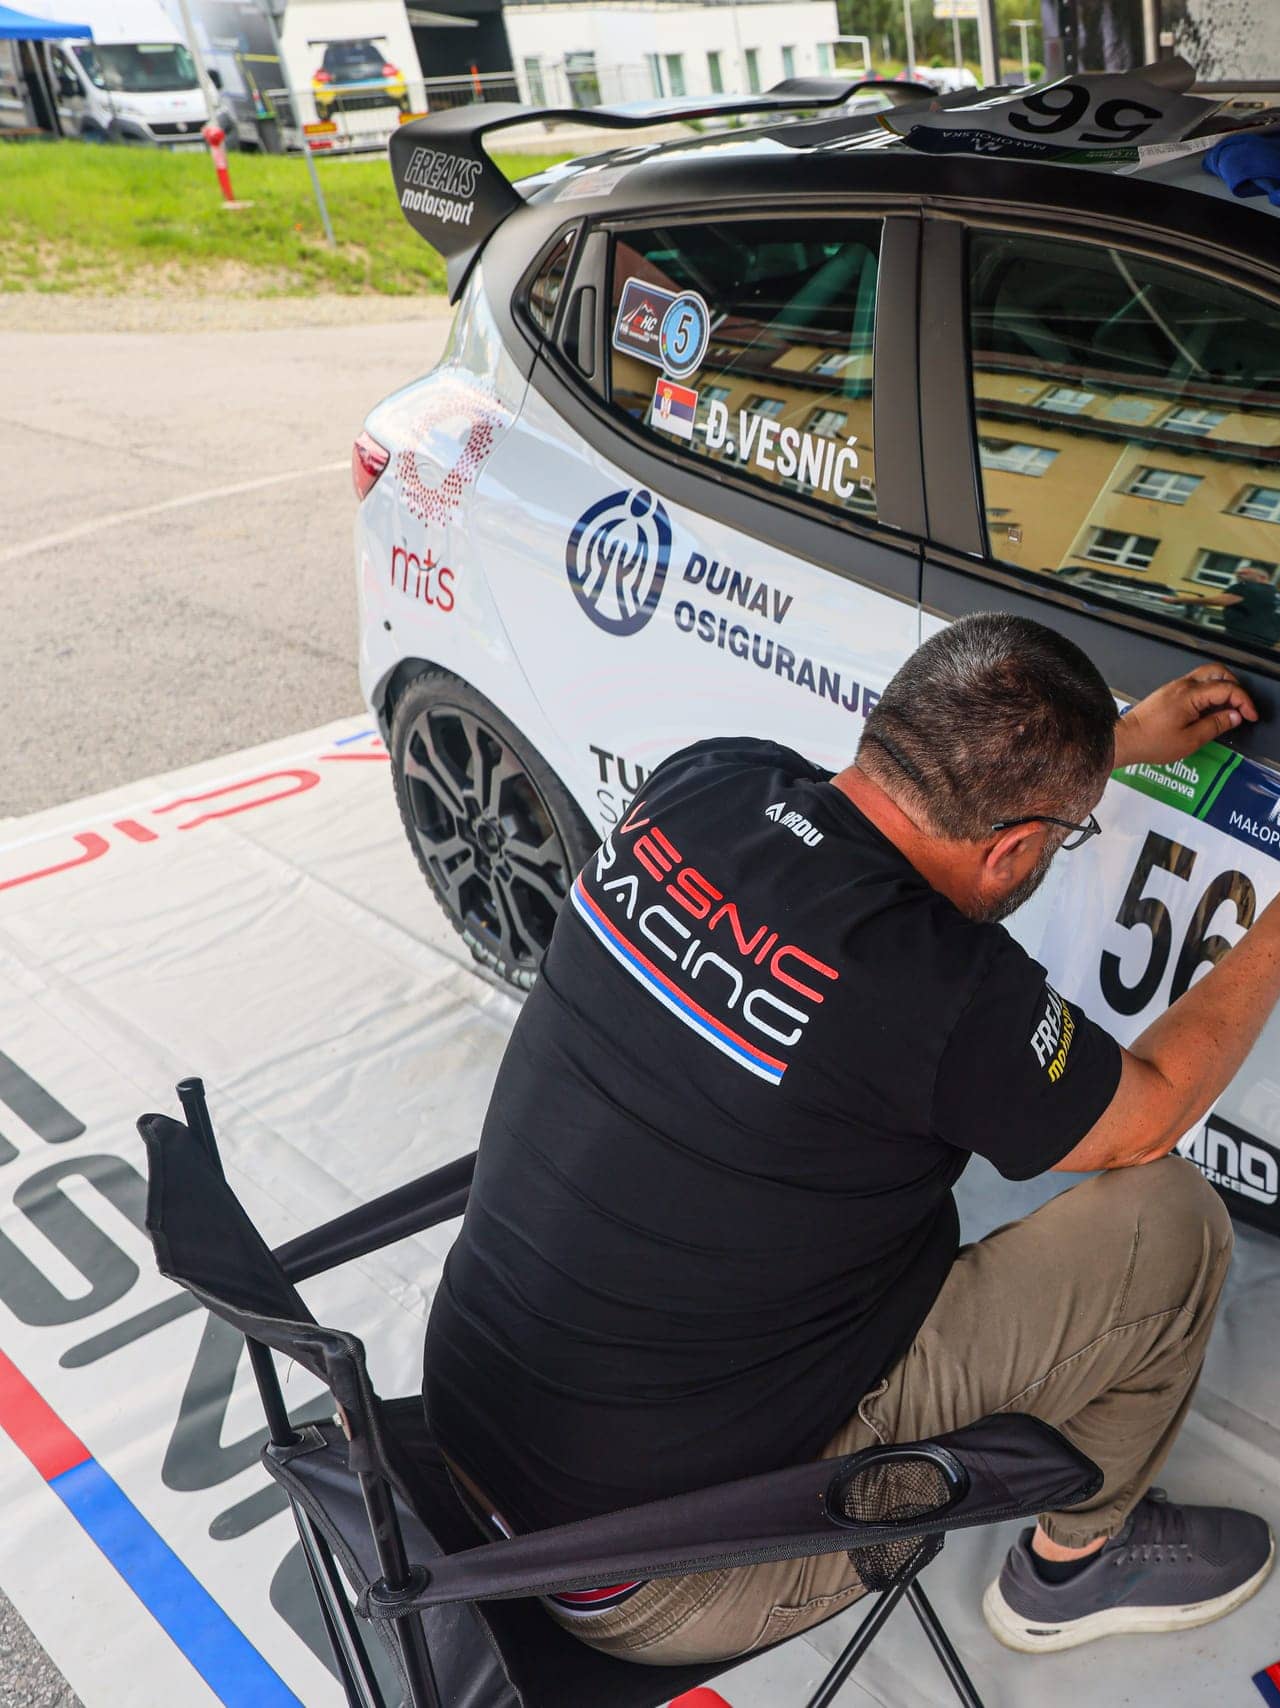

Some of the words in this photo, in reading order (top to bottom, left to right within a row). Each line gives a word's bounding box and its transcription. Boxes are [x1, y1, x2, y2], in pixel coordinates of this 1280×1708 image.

[401, 188, 474, 226] motorsport
[404, 147, 483, 198] FREAKS
[673, 313, 694, 355] 5
[705, 399, 859, 499] Đ.VESNIĆ
[391, 545, 455, 613] mts
[683, 552, 794, 625] DUNAV
[674, 600, 881, 718] OSIGURANJE
[1138, 764, 1196, 798] Limanowa
[620, 800, 840, 1004] VESNIC
[593, 835, 810, 1047] RACING
